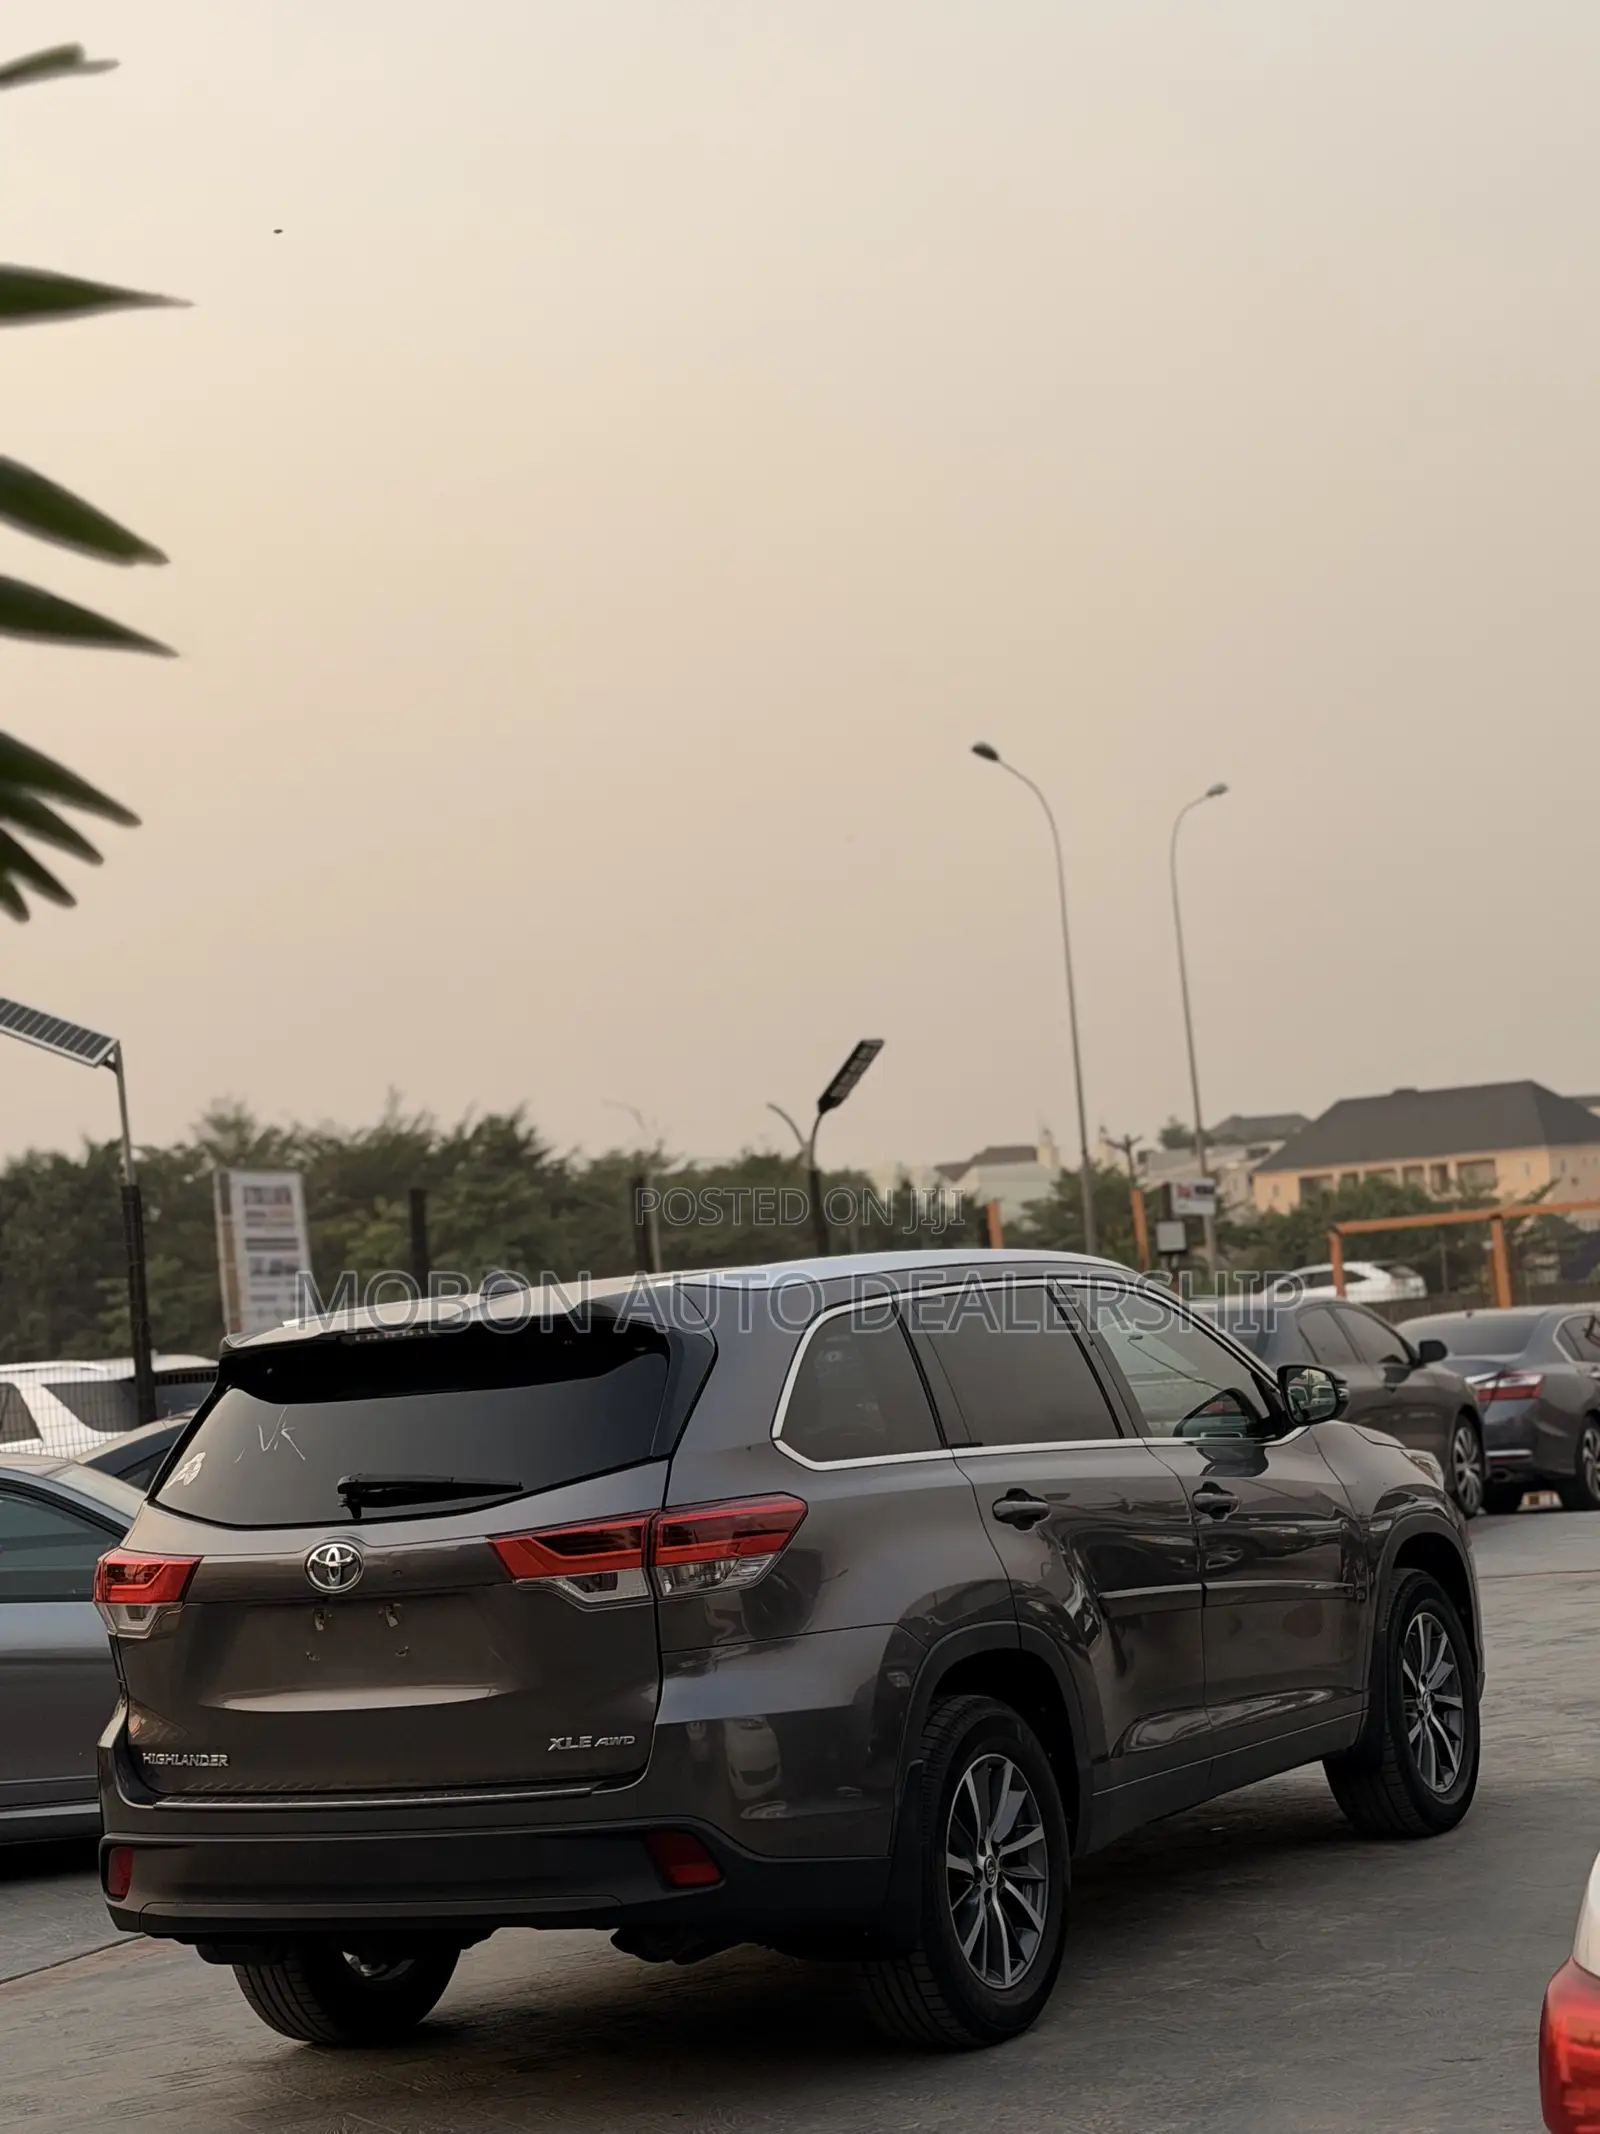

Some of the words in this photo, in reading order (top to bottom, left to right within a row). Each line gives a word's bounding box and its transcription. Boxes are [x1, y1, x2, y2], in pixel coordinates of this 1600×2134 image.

[547, 1735, 593, 1752] XLE
[594, 1735, 636, 1748] AWD
[142, 1752, 229, 1767] HIGHLANDER
